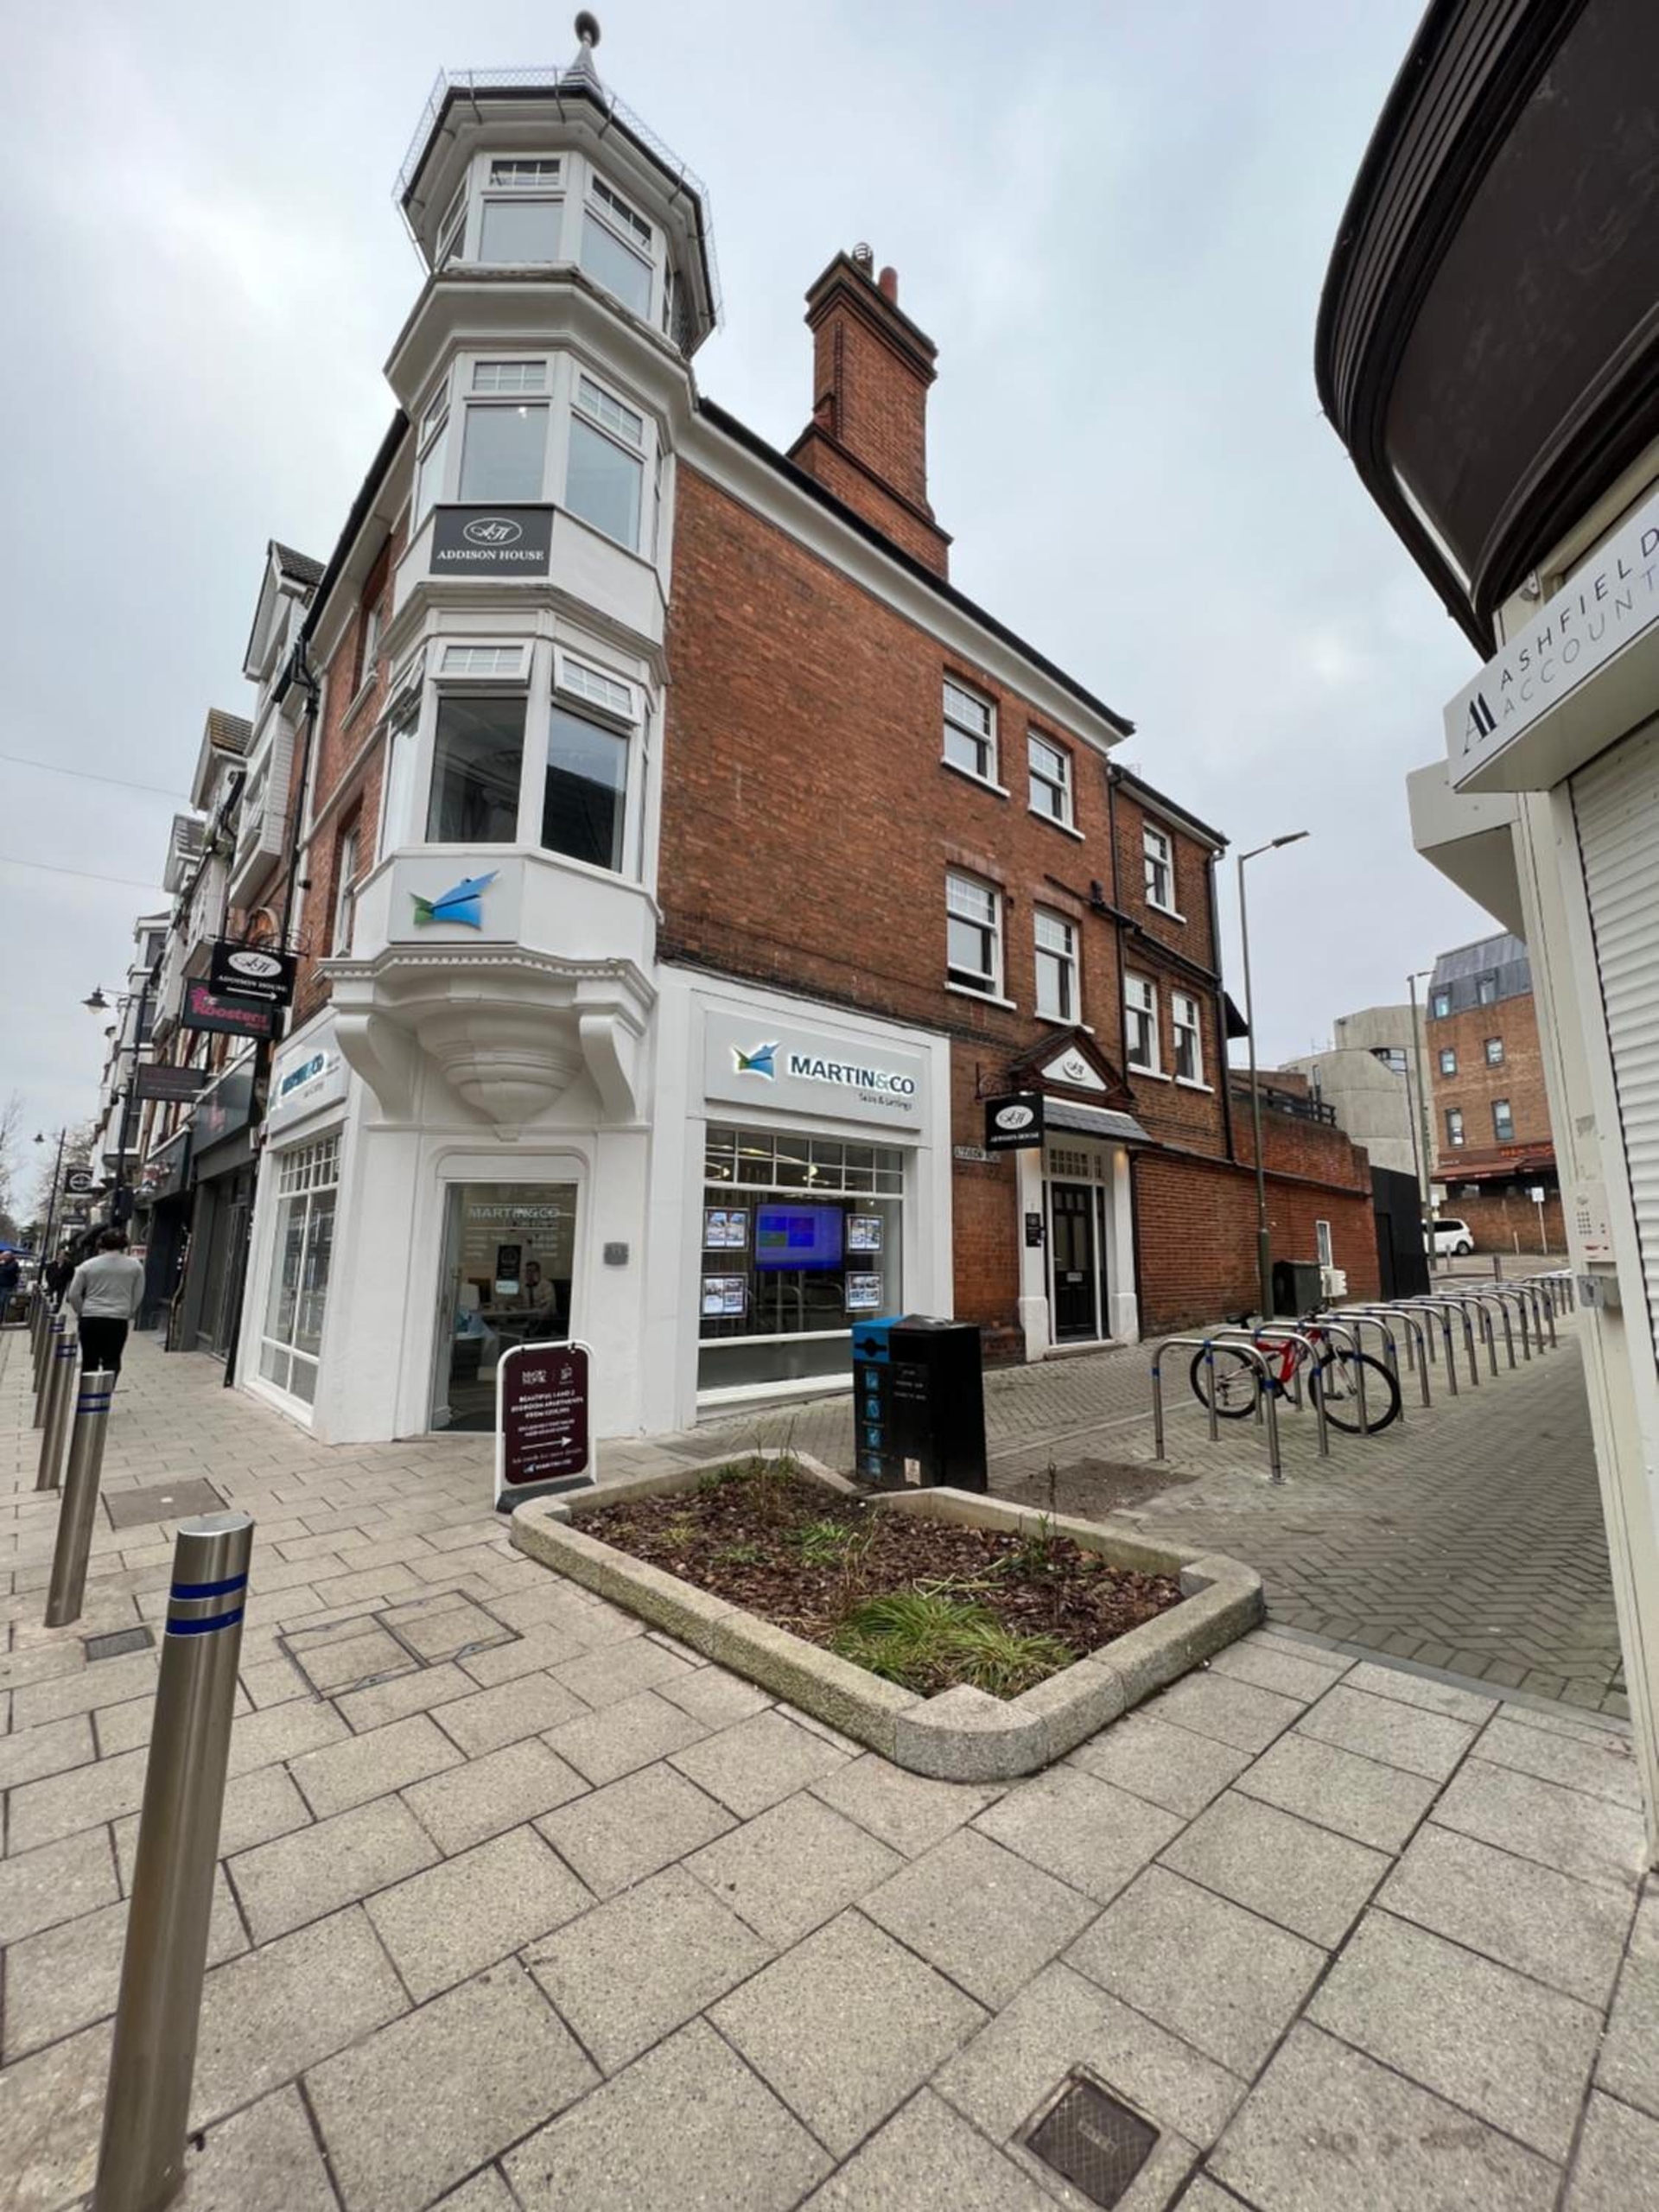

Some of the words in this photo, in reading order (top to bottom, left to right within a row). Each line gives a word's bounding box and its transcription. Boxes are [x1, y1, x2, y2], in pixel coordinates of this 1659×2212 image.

[436, 550, 497, 560] ADDISON
[499, 550, 545, 562] HOUSE
[217, 975, 257, 987] ADDISON
[258, 981, 288, 993] HOUSE
[790, 1055, 915, 1095] MARTIN&CO
